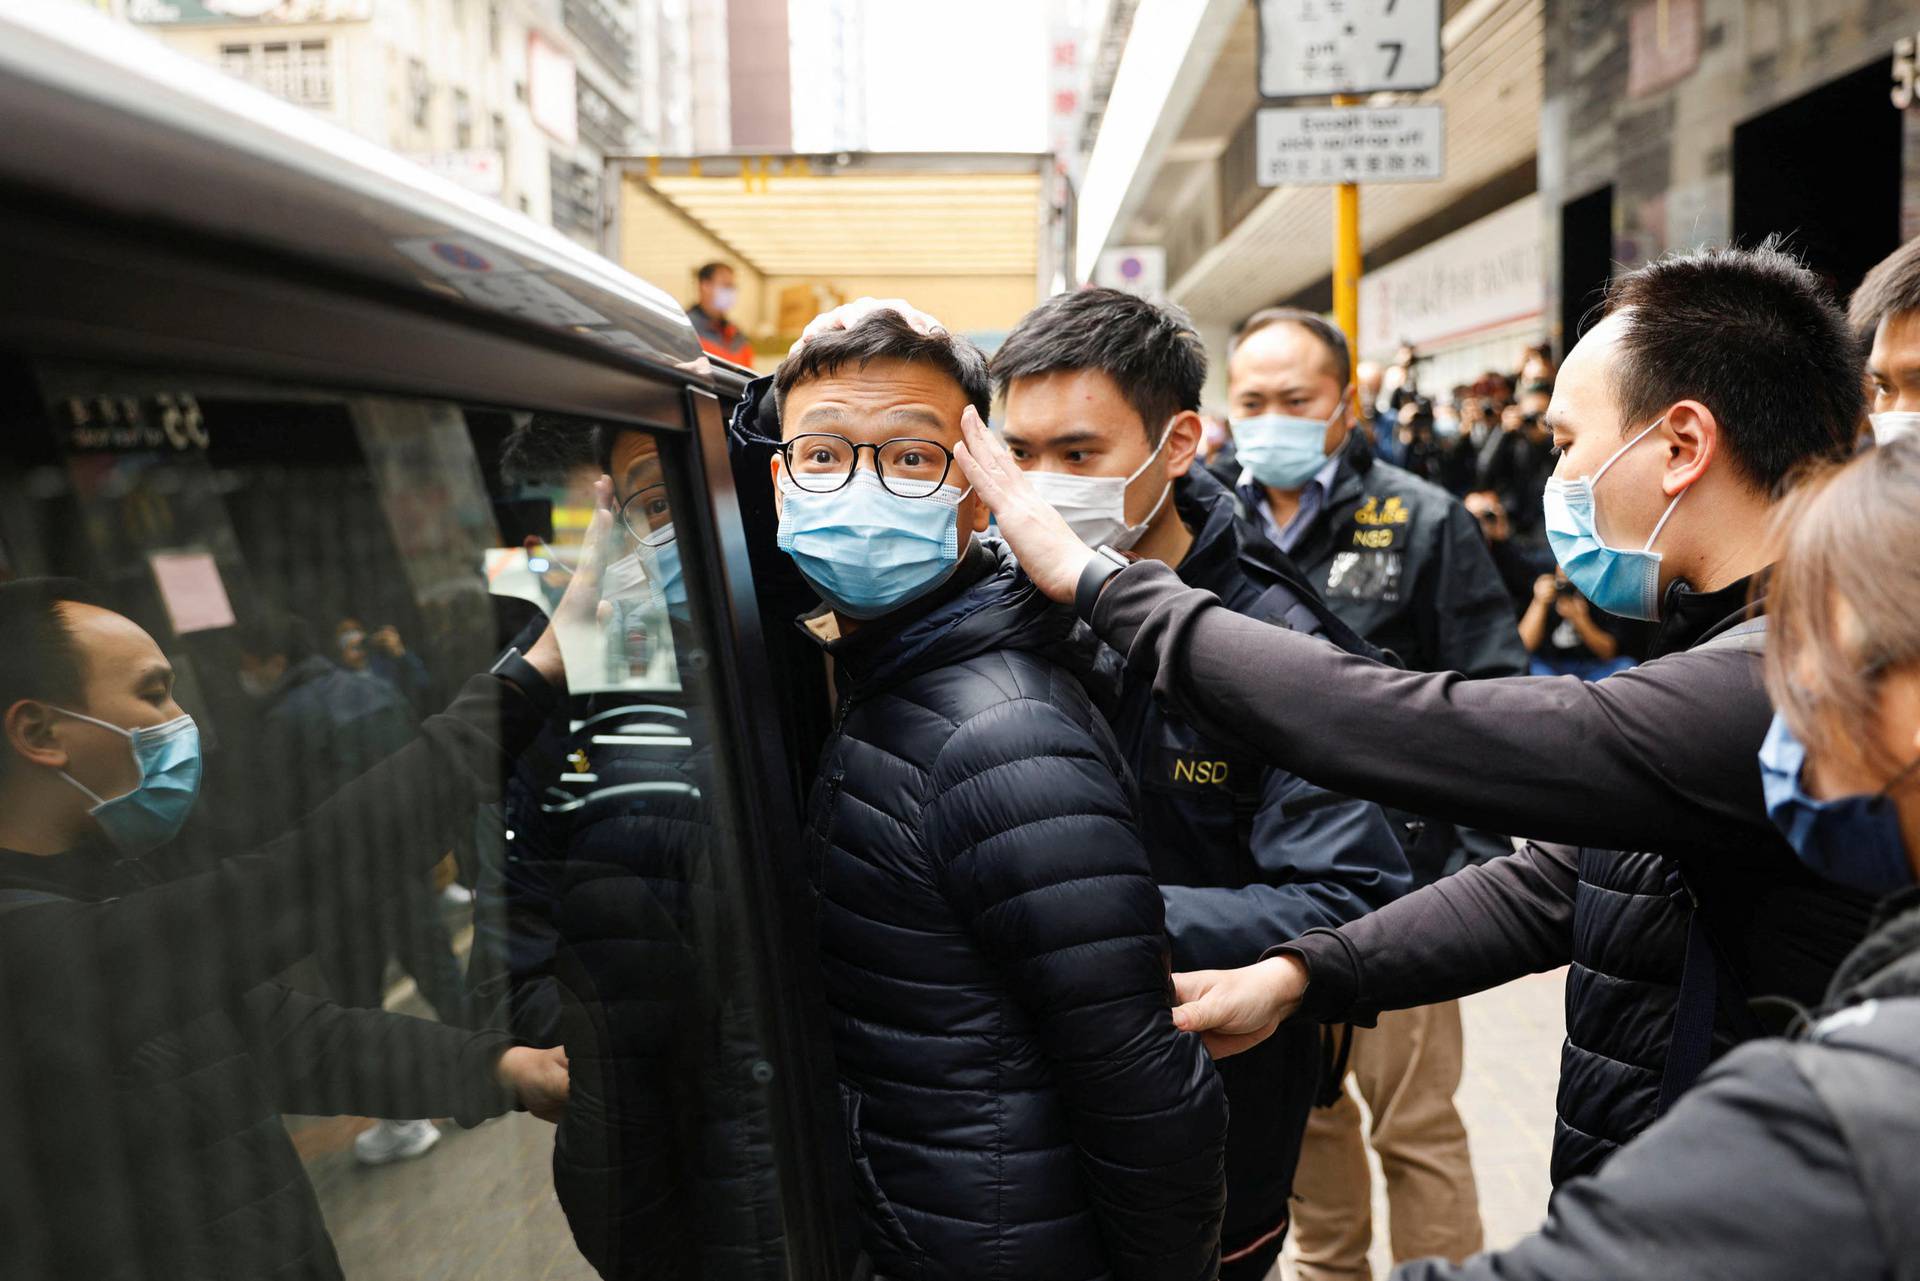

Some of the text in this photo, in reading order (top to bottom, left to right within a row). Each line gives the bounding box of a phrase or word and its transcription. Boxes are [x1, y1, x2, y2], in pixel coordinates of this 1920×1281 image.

[1376, 40, 1404, 79] 7
[1302, 115, 1363, 131] Except
[1352, 528, 1394, 548] NSD
[1174, 757, 1229, 784] NSD
